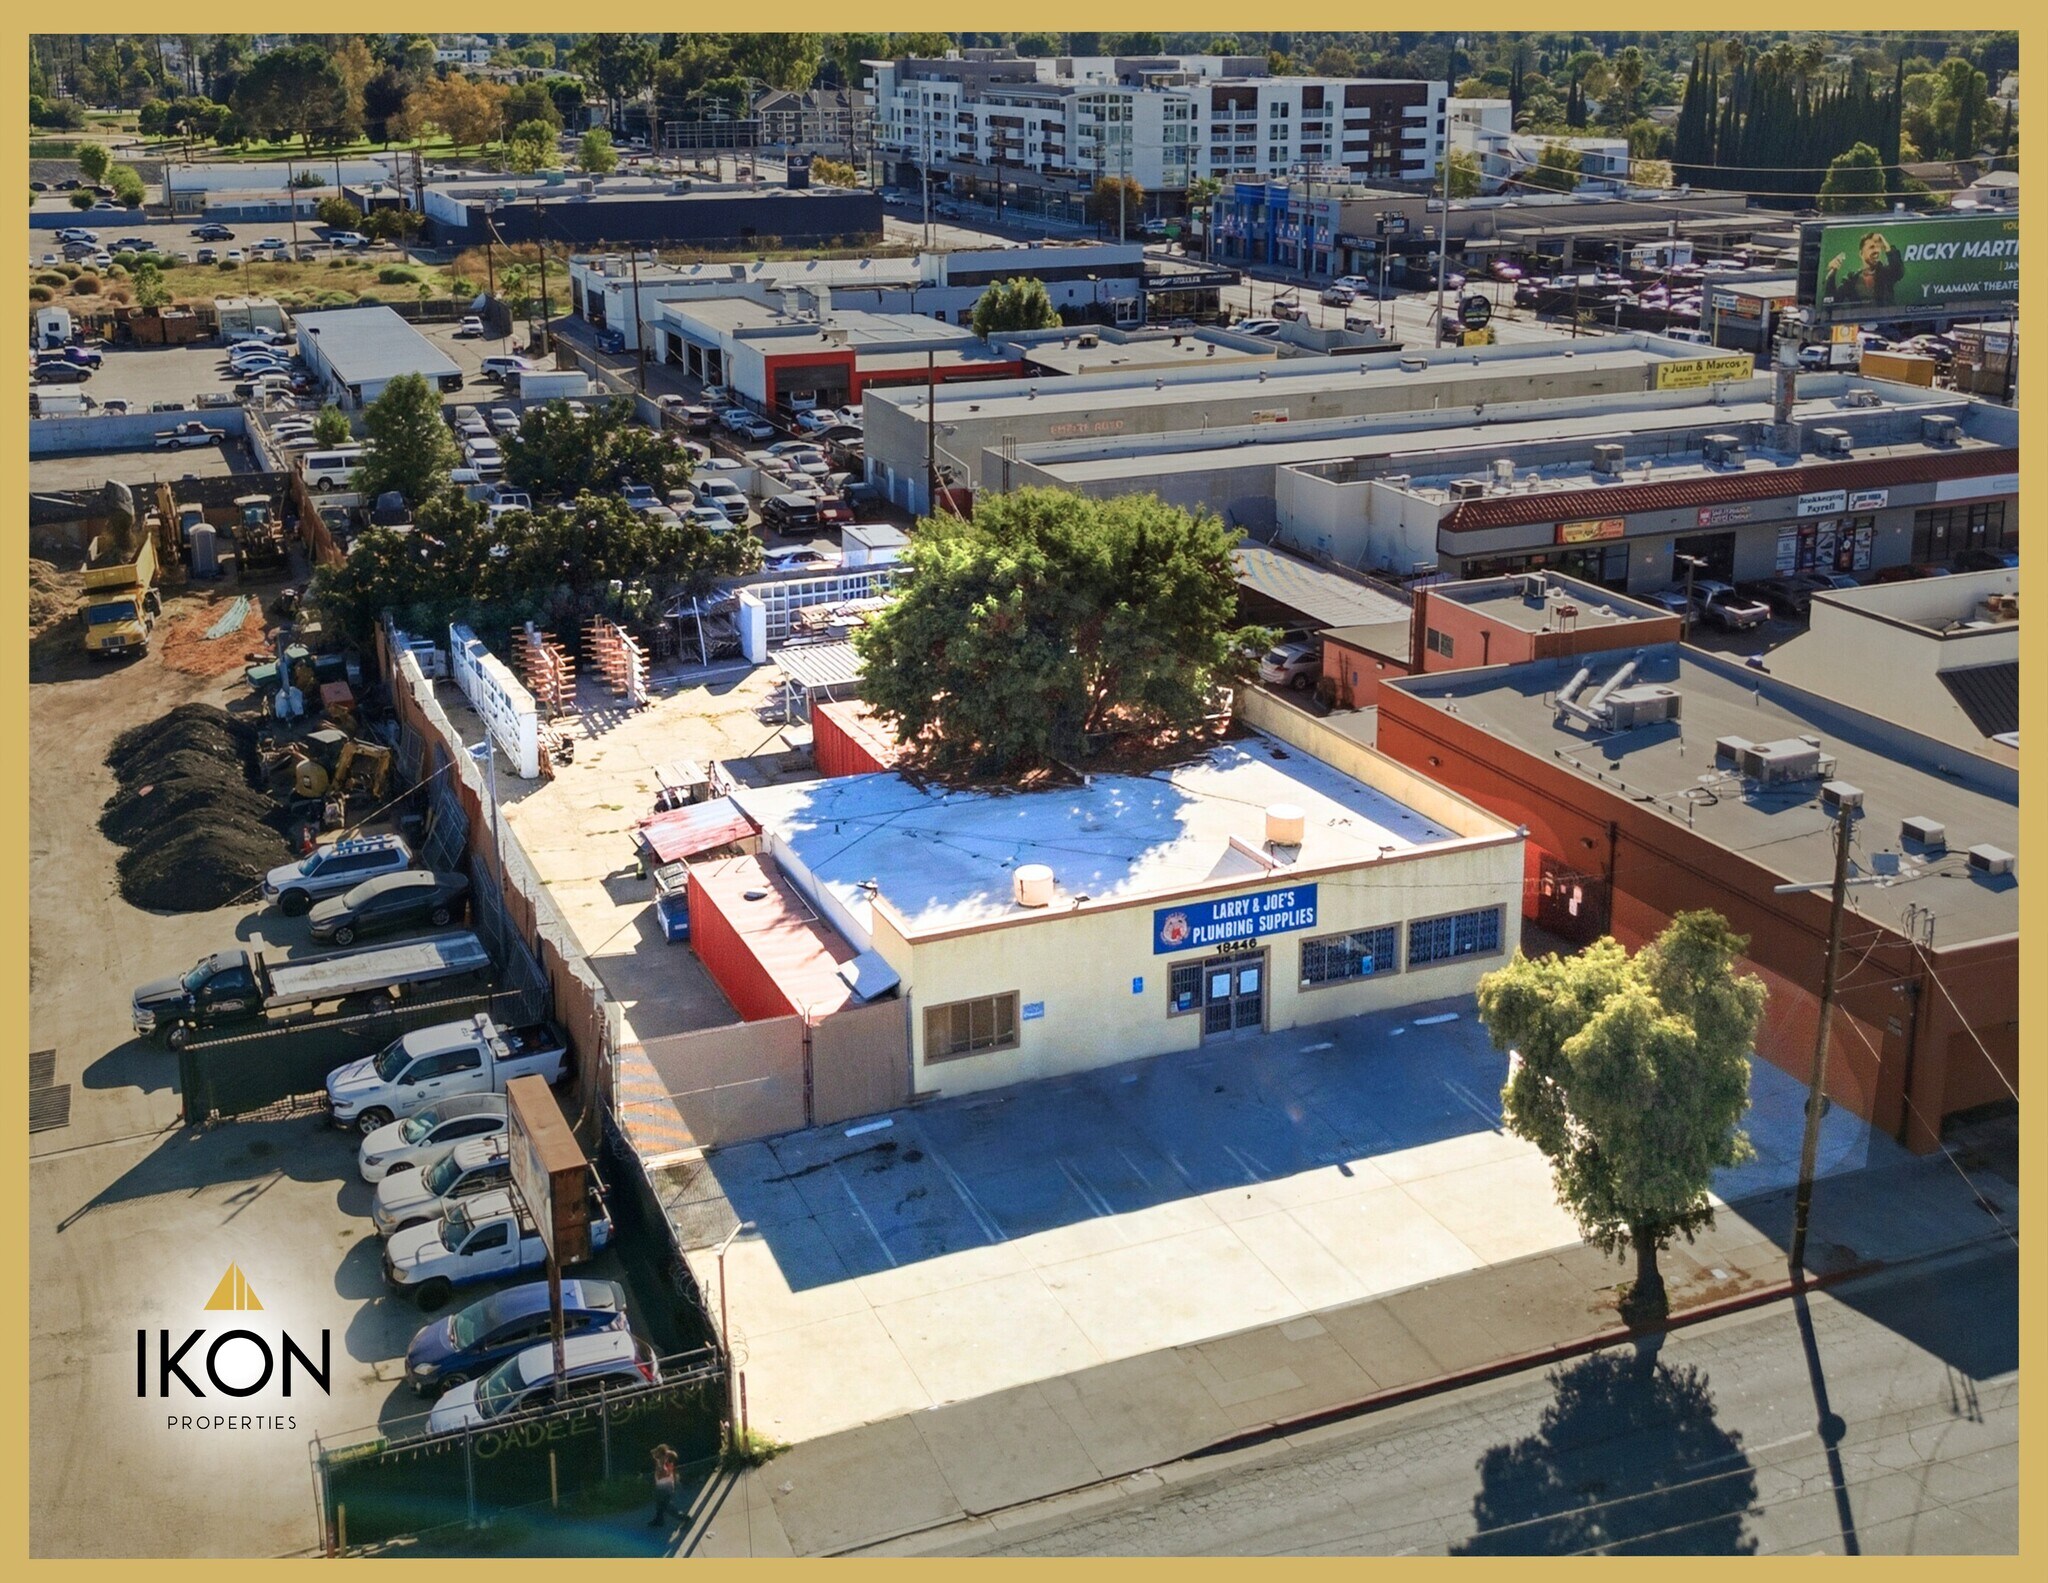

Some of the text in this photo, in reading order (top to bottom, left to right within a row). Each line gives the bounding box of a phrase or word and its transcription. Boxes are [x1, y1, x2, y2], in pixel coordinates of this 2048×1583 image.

[1904, 242, 1960, 261] RICKY
[1670, 360, 1740, 374] Juan & Marcos
[1213, 891, 1295, 920] LARRY & JOE'S
[1193, 908, 1314, 943] PLUMBING SUPPLIES
[1216, 938, 1257, 954] 18446
